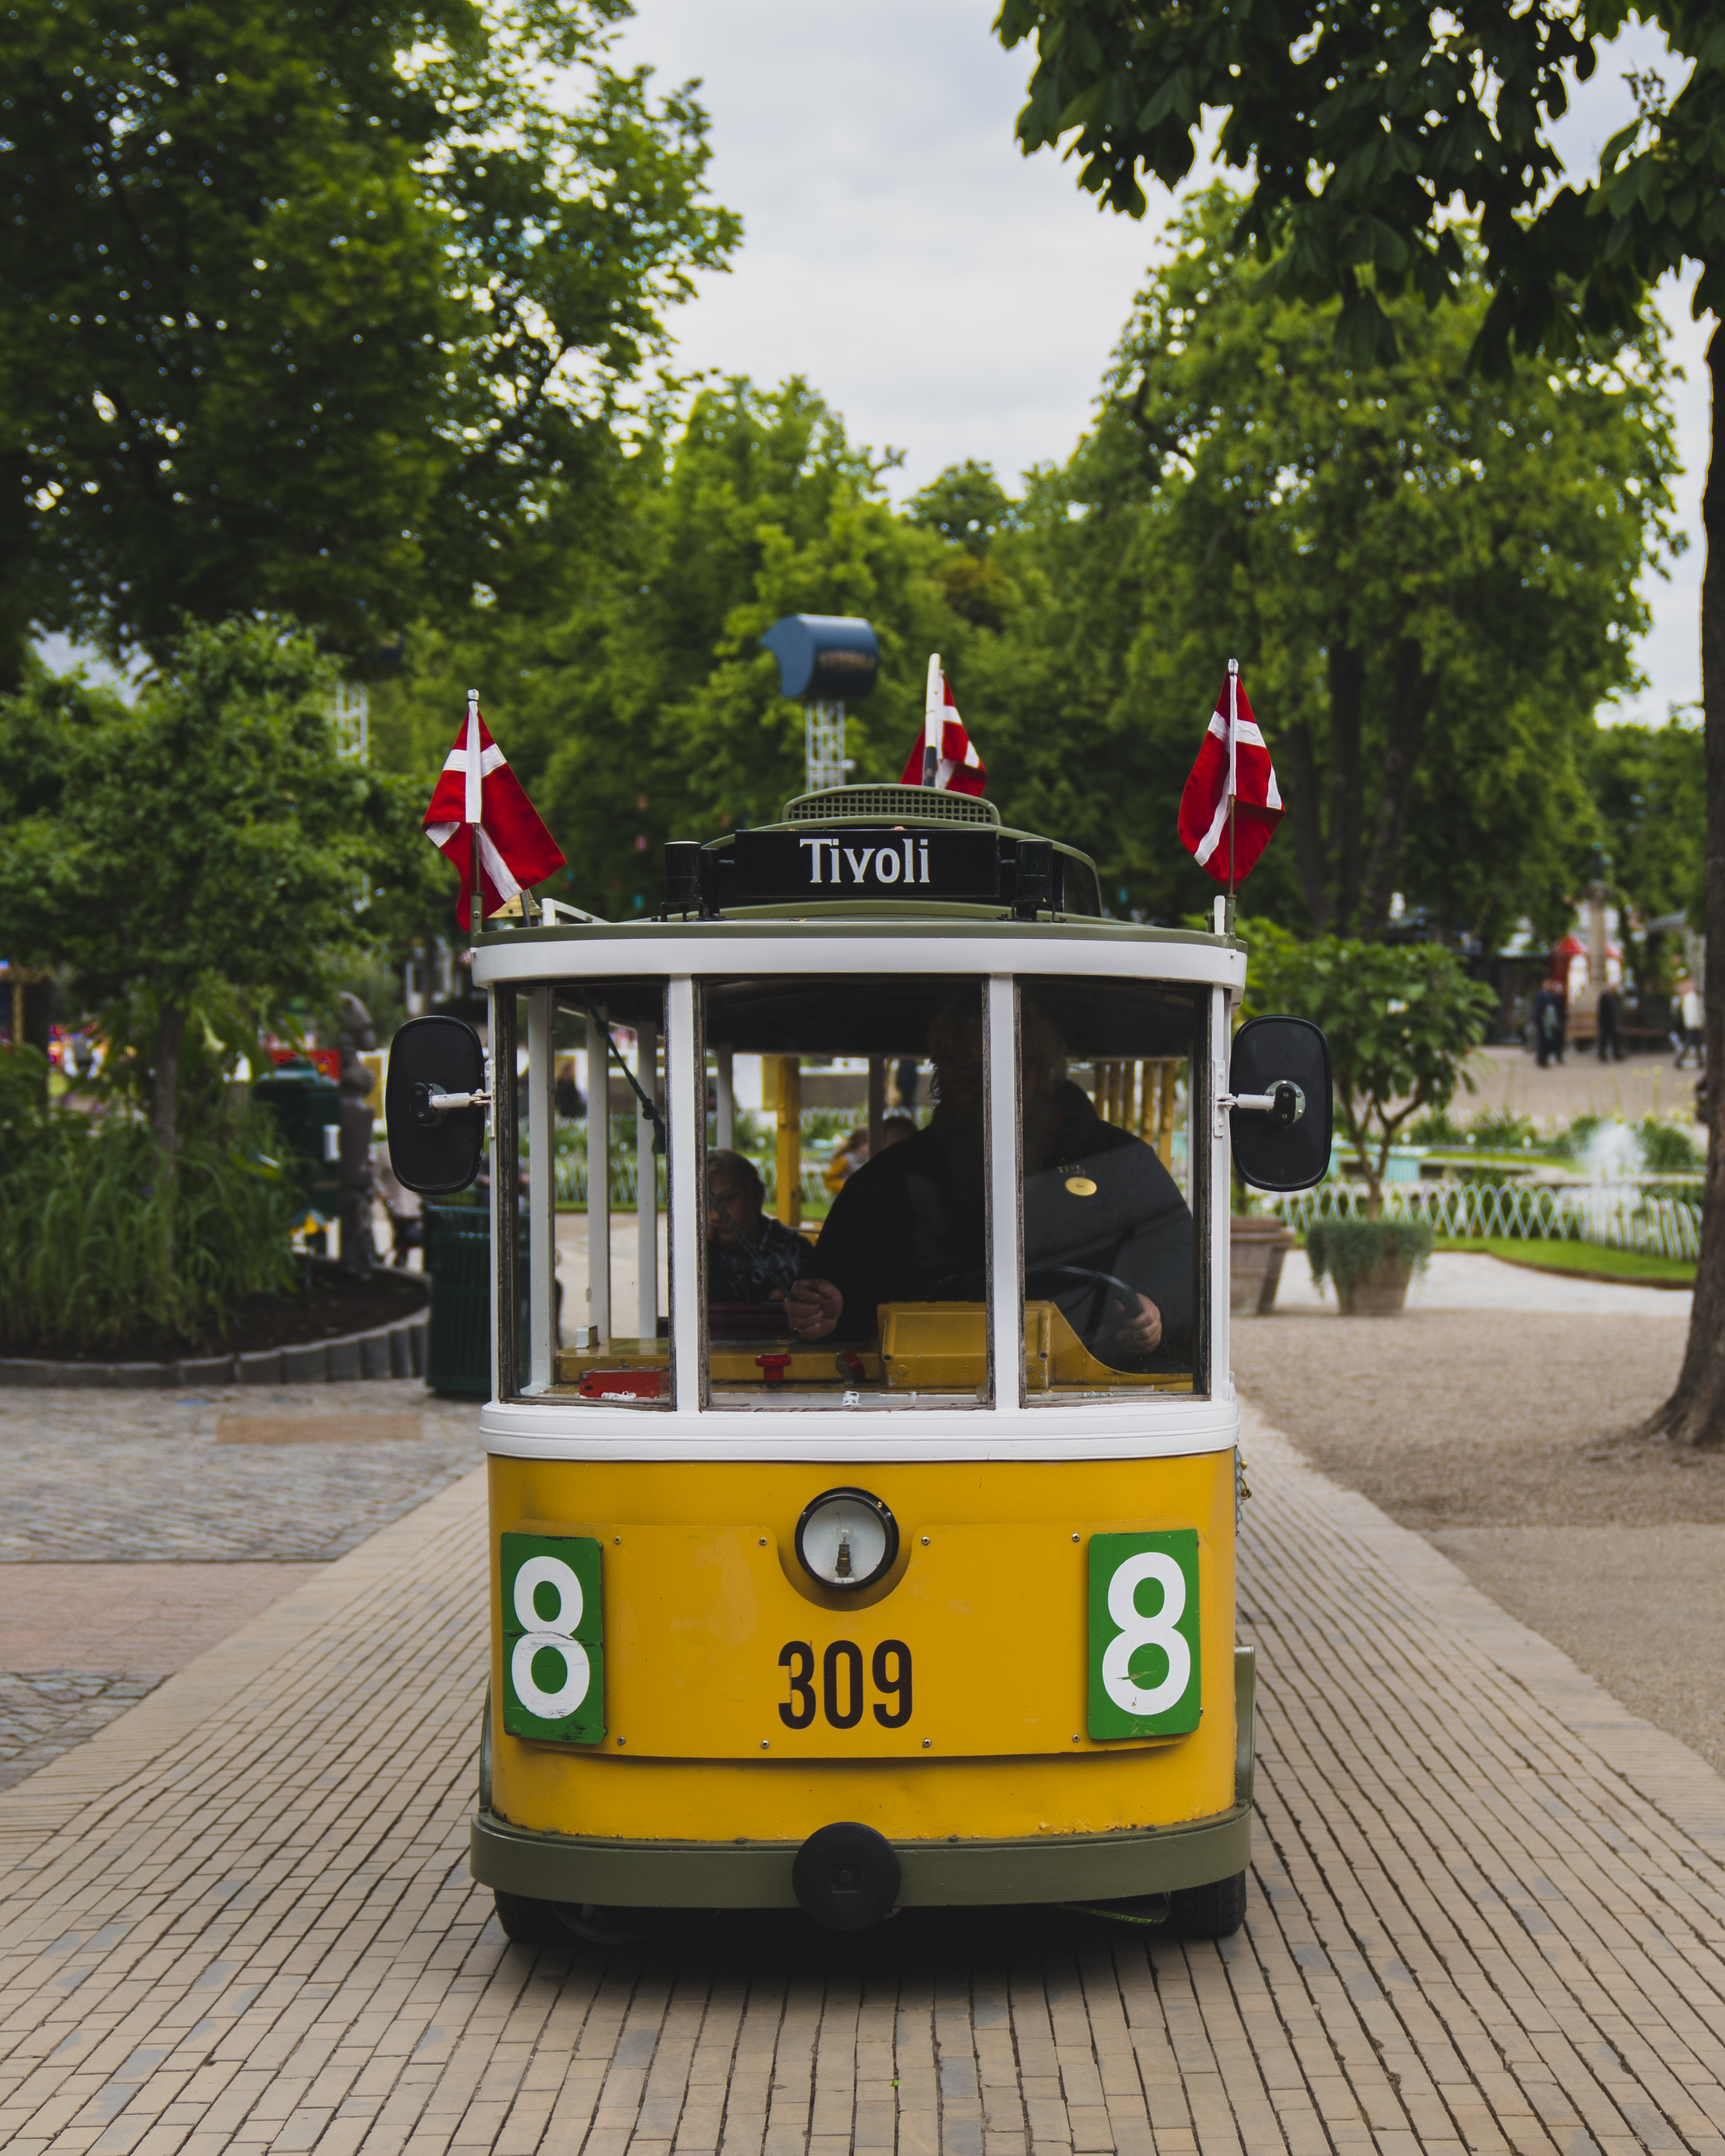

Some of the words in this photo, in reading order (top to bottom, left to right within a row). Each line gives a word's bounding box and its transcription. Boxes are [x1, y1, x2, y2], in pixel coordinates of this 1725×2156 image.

[799, 838, 930, 883] Tivoli
[1056, 1164, 1090, 1175] TIVO
[511, 1556, 590, 1719] 8
[1102, 1552, 1191, 1715] 8
[778, 1639, 912, 1729] 309
